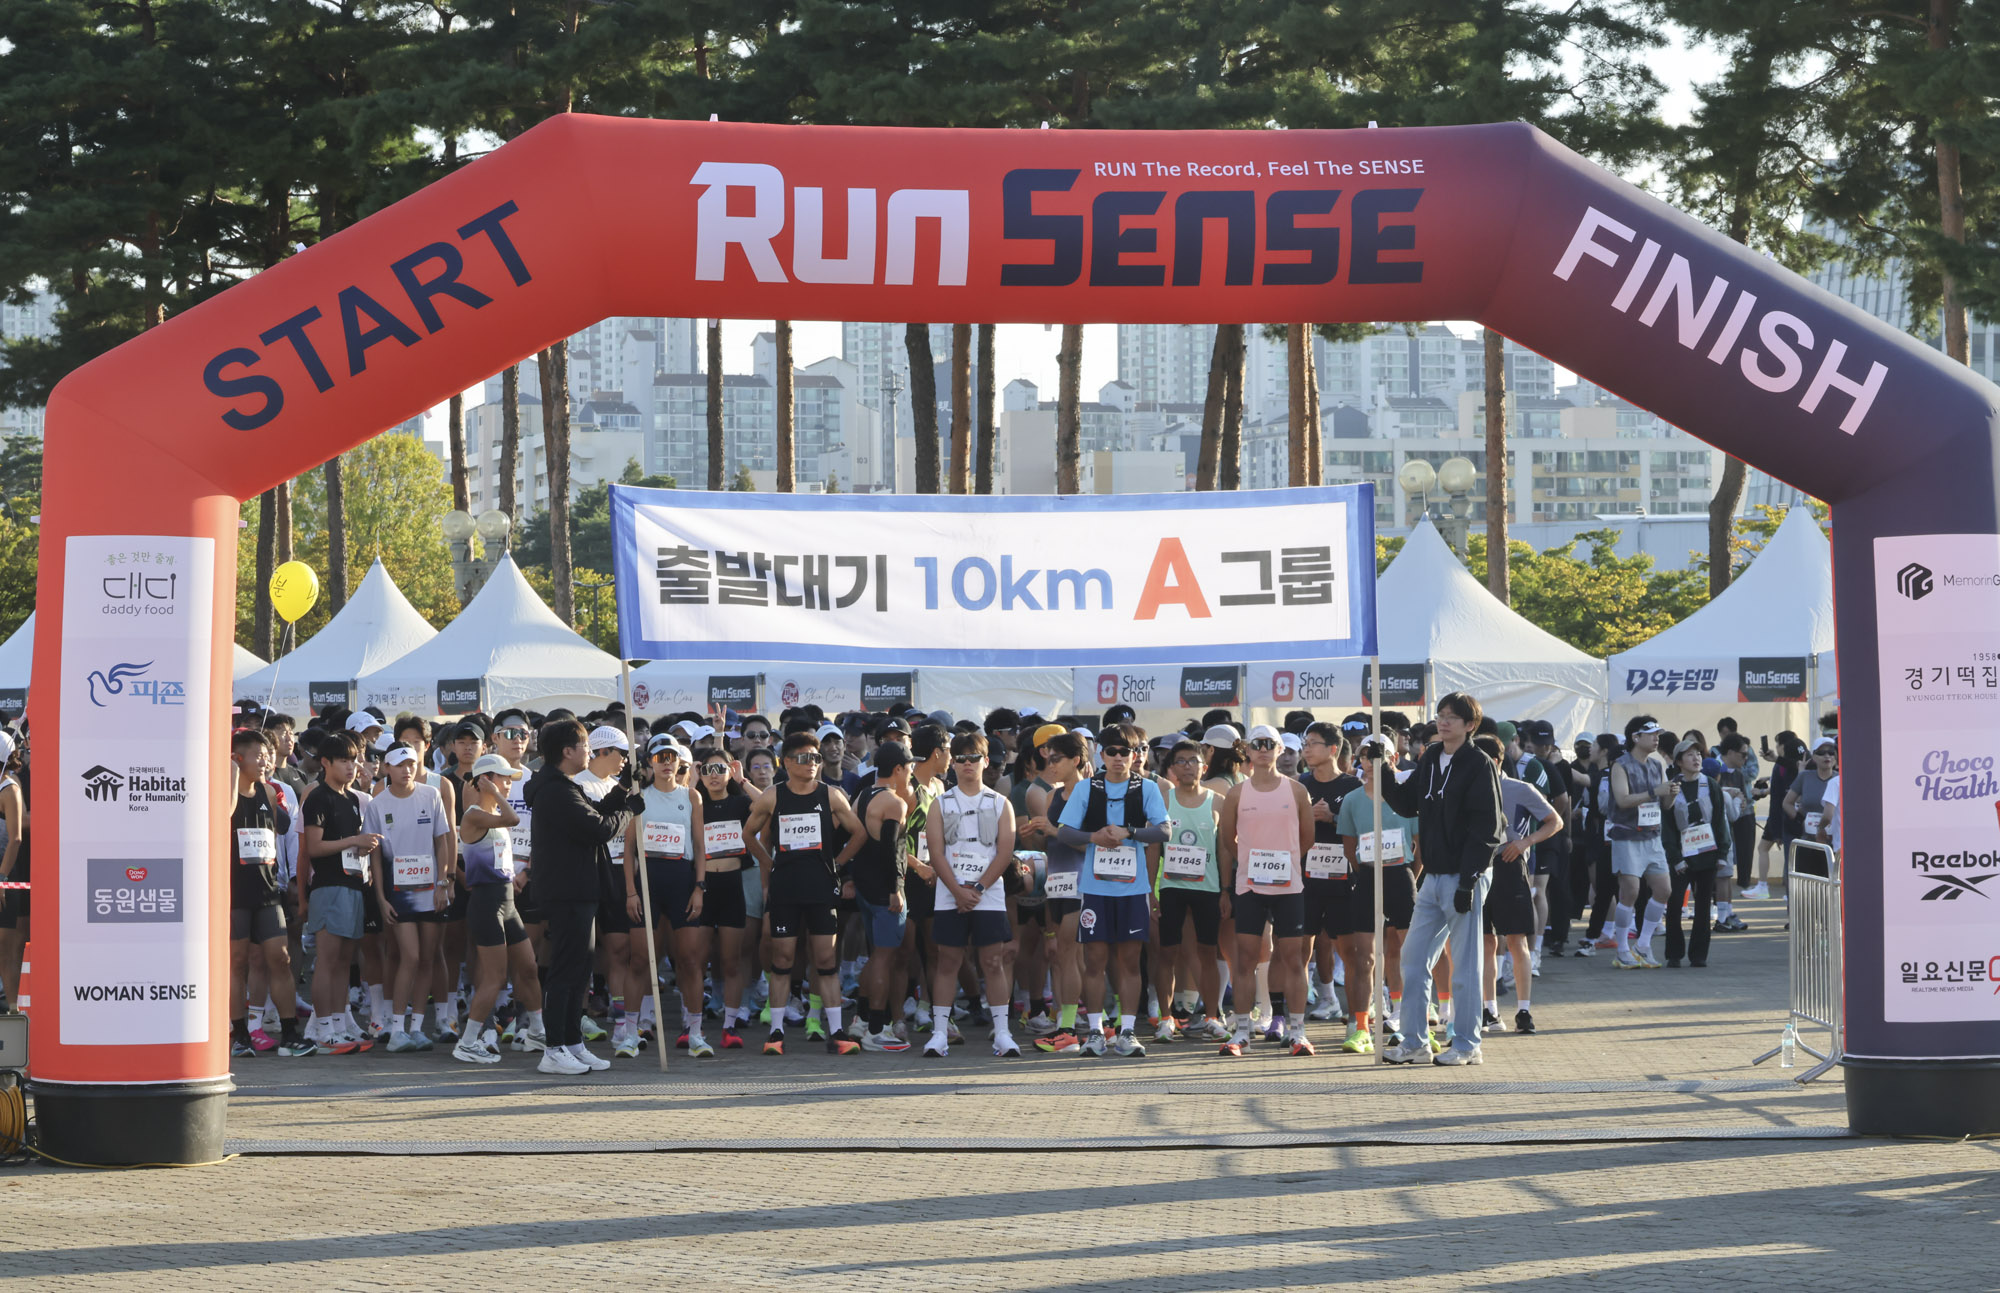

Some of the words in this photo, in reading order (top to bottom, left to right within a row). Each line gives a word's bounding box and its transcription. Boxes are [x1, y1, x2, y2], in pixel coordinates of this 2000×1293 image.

[1094, 162, 1137, 177] RUN
[1142, 162, 1181, 176] The
[1188, 161, 1262, 179] Record,
[1268, 161, 1309, 176] Feel
[1314, 160, 1353, 175] The
[1359, 159, 1425, 175] SENSE
[203, 200, 532, 431] START
[1552, 206, 1889, 436] FINISH
[656, 545, 888, 613] 출발대기
[914, 553, 1113, 613] 10km
[102, 604, 142, 616] daddy
[145, 604, 174, 615] food
[1973, 653, 1997, 661] 1958
[1123, 675, 1156, 691] Short
[1299, 672, 1335, 688] Short
[128, 680, 186, 705] 피죤
[1906, 694, 1945, 702] KYUNGGI
[1947, 693, 1973, 701] TTEOK
[1922, 750, 1994, 775] Choco
[129, 766, 166, 774] 한국해비타트
[129, 776, 186, 792] Habitat
[1915, 771, 1999, 801] Health
[129, 793, 141, 802] for
[129, 804, 149, 812] Korea
[792, 825, 816, 834] 1095
[656, 834, 680, 843] 2210
[716, 832, 739, 841] 2570
[1108, 857, 1131, 866] 1411
[1178, 856, 1201, 866] 1845
[1319, 855, 1343, 864] 1677
[1912, 850, 2000, 872] Reebok
[407, 866, 430, 875] 2019
[960, 863, 983, 873] 1234
[1262, 862, 1285, 870] 1061
[1054, 883, 1073, 893] 1784
[94, 888, 177, 915] 동원샘물
[1900, 960, 1986, 983] 일요신문
[74, 985, 144, 1001] WOMAN
[149, 984, 197, 1000] SENSE
